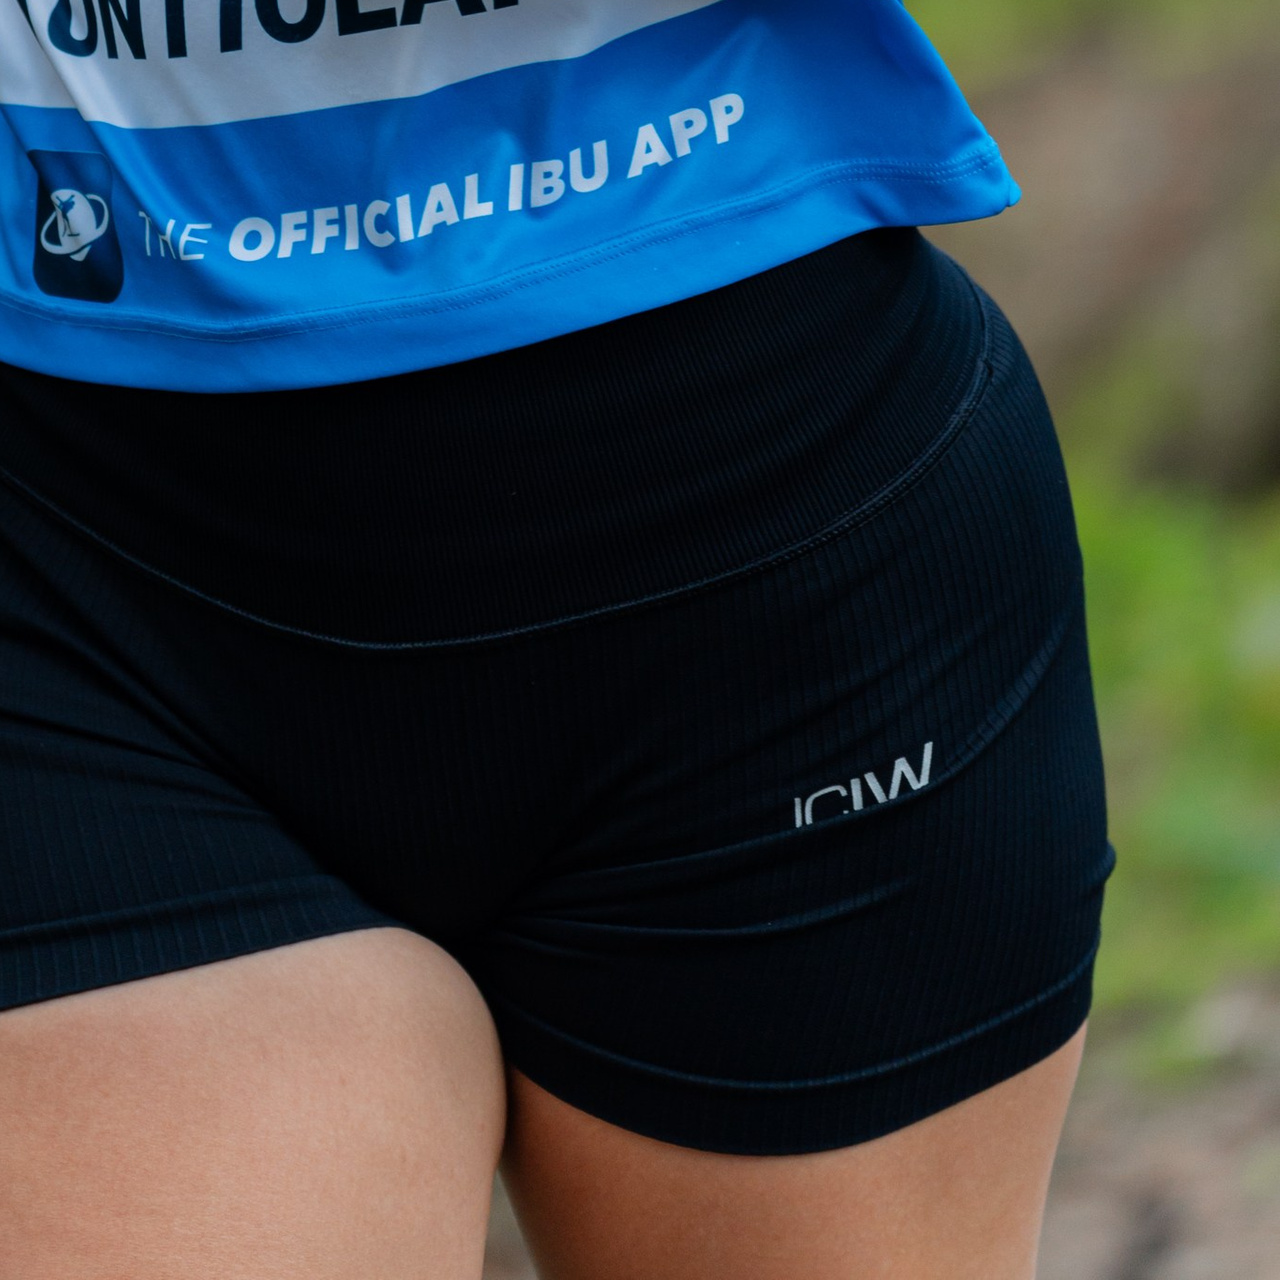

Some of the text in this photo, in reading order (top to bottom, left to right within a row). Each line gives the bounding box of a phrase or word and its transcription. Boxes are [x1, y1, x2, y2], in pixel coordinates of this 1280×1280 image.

[138, 93, 744, 262] THE OFFICIAL IBU APP
